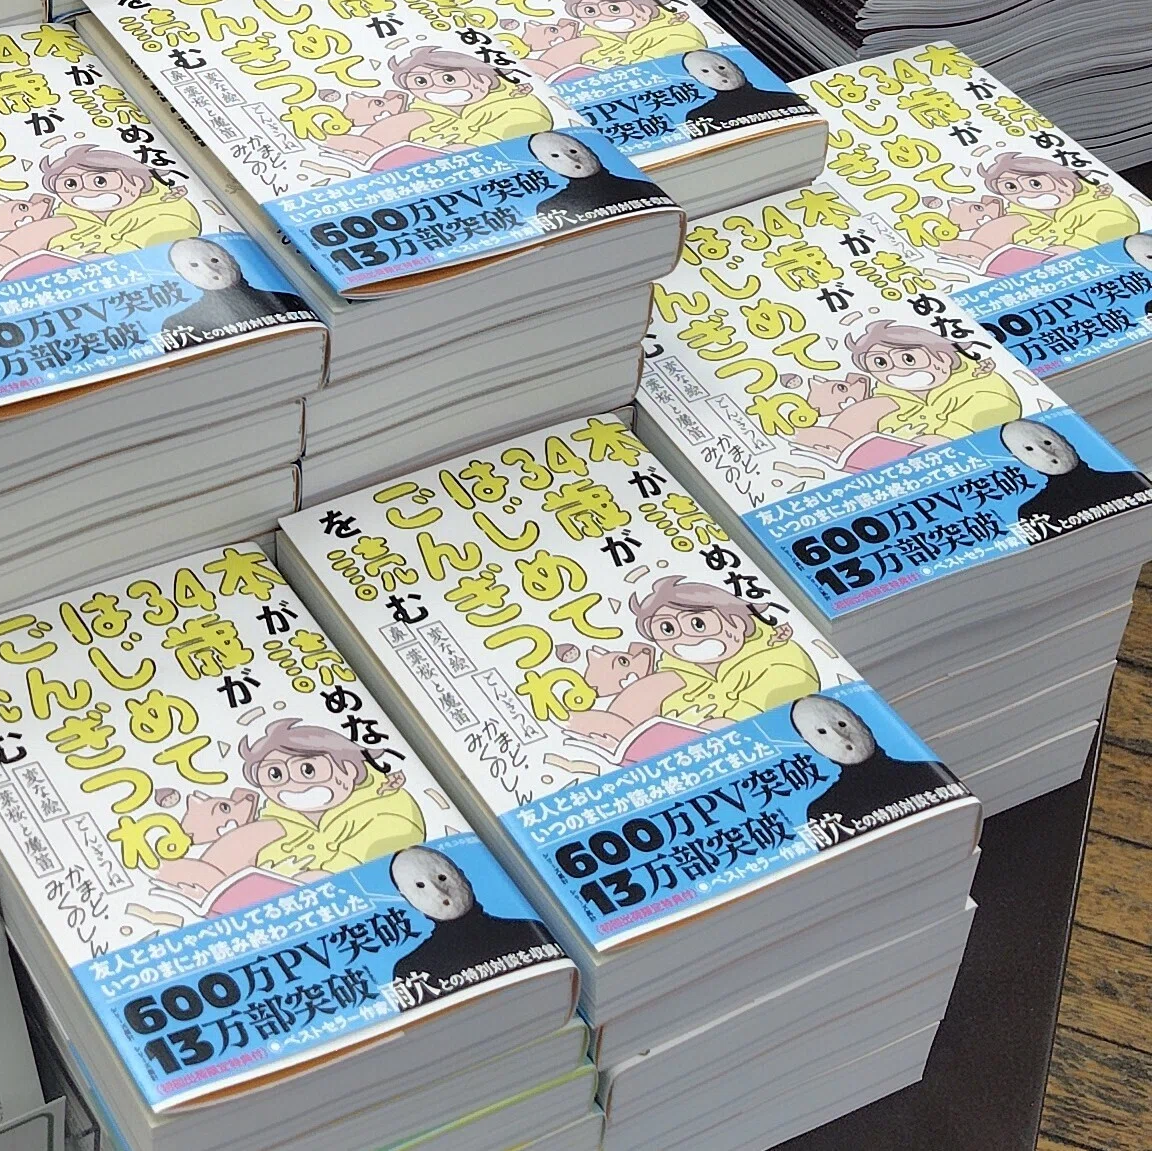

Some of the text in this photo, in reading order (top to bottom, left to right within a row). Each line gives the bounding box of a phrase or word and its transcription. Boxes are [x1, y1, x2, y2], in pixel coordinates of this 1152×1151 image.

[22, 25, 188, 186] 本が読めない
[858, 59, 981, 145] 34歳が
[913, 48, 1108, 185] 本が読めない
[309, 169, 556, 246] 600万PV突破
[722, 207, 853, 311] 34歳が
[667, 227, 840, 371] はじめて
[785, 194, 990, 360] 本が読めない
[652, 281, 822, 439] んぎつね
[319, 510, 428, 625] を読む
[440, 462, 621, 639] はじめて
[501, 437, 641, 566] 34歳が
[572, 419, 788, 626] 本が読めない
[790, 464, 1035, 564] 600万PV突破
[814, 511, 1008, 594] 13万部突破
[126, 568, 260, 707] 34歳が
[204, 551, 405, 773] 本が読めない
[374, 482, 597, 720] ごんぎつね
[59, 594, 226, 784] はじめて
[555, 753, 827, 878] 600万PV突破
[579, 811, 794, 914] 13万部突破
[124, 908, 420, 1034] 600万PV突破
[144, 968, 376, 1072] 13万部突破
